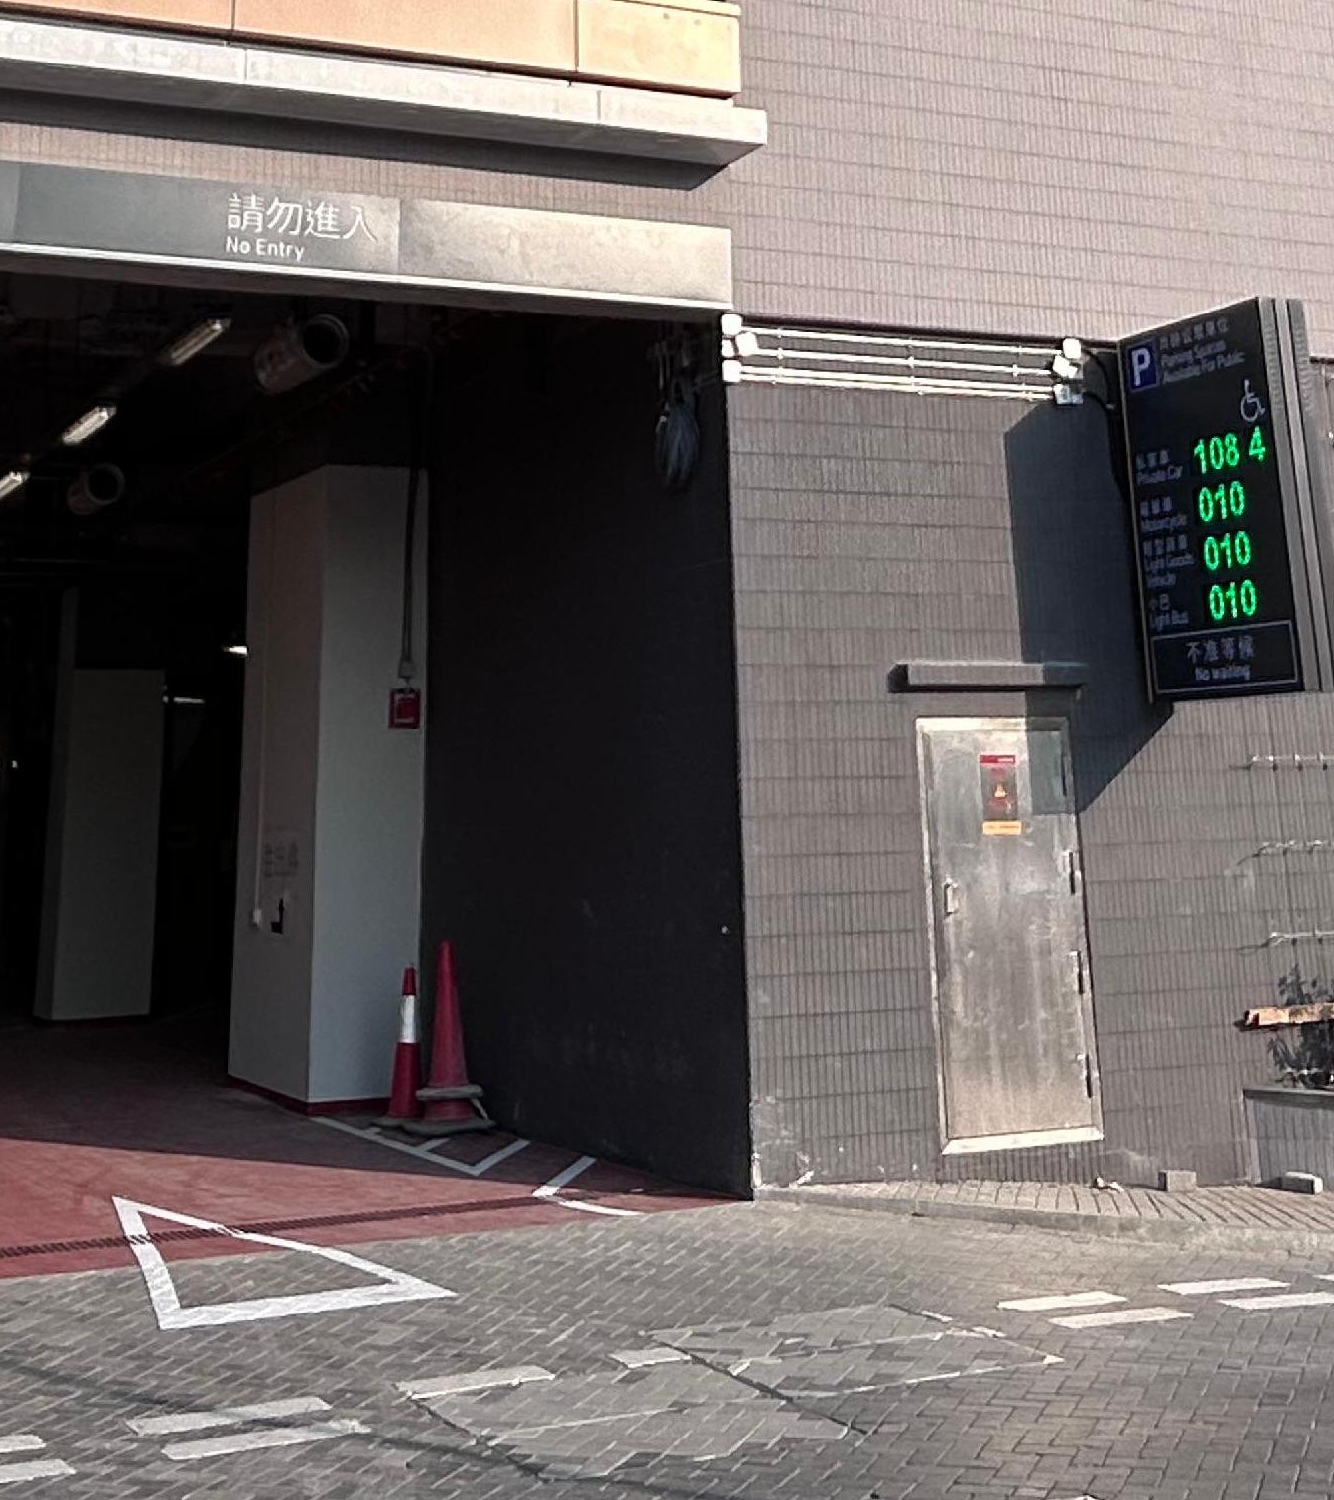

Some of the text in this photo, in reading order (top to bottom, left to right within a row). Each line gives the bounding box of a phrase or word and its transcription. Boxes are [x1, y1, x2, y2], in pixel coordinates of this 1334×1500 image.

[227, 192, 379, 244] 請勿進入
[226, 236, 305, 262] No Entry
[1131, 347, 1152, 387] P
[1193, 426, 1267, 475] 108 4
[1198, 480, 1246, 522] 010
[1203, 530, 1252, 572] 010
[1208, 579, 1258, 623] 010
